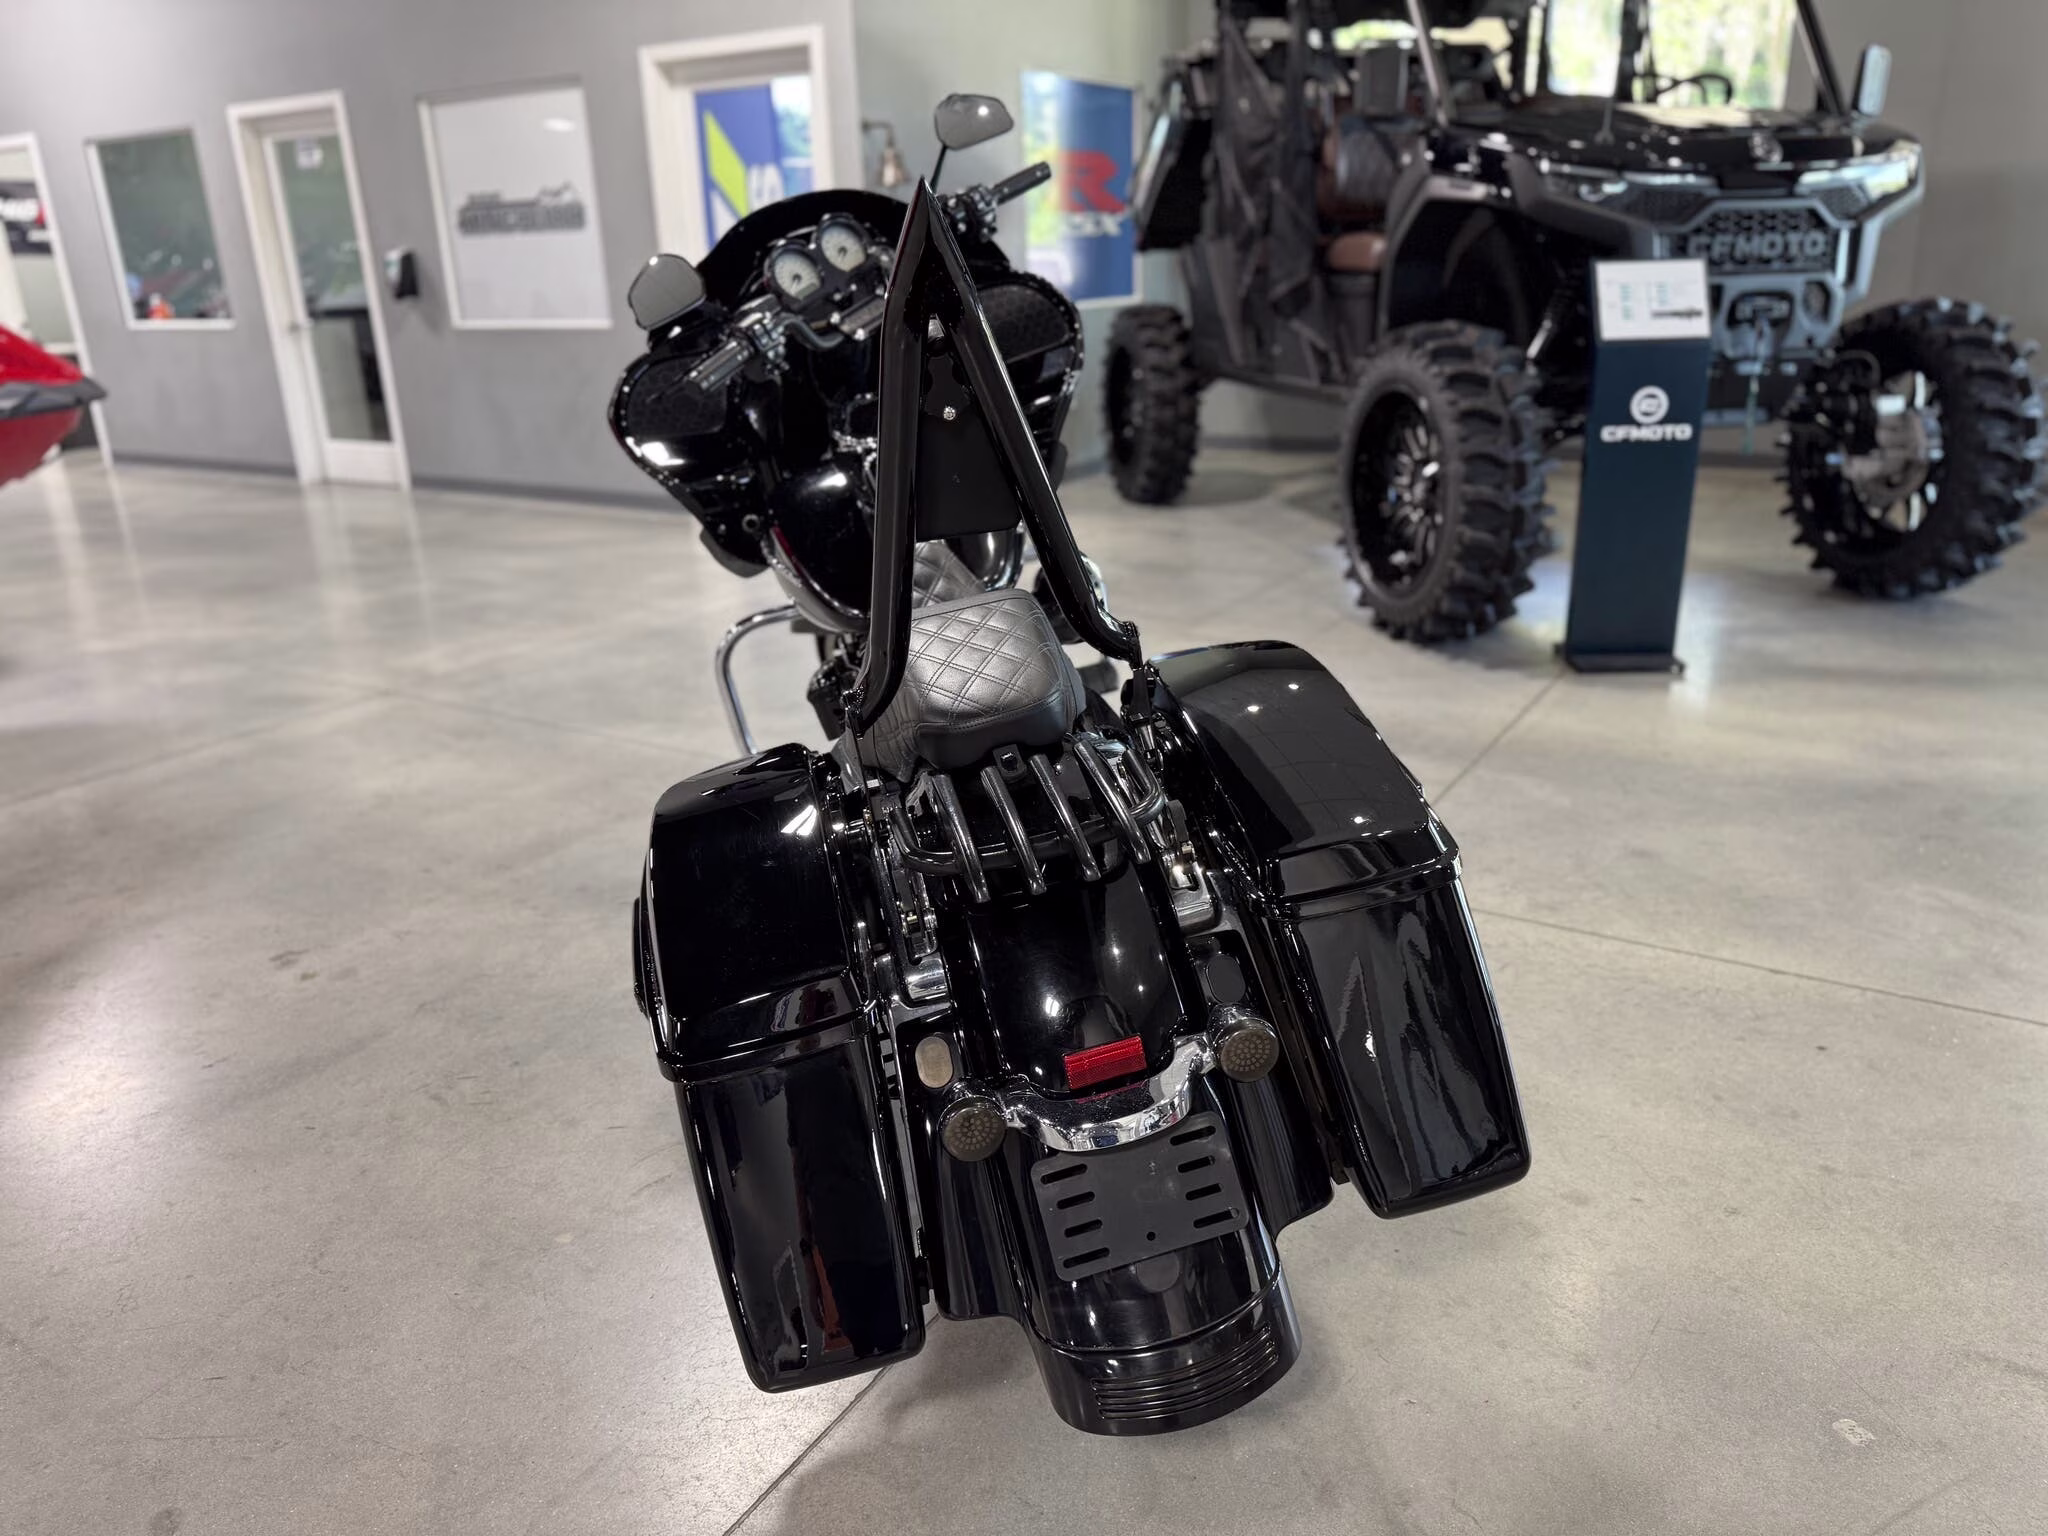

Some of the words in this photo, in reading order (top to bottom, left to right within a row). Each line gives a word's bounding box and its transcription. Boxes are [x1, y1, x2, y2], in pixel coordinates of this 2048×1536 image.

[1058, 149, 1125, 213] R
[1687, 230, 1826, 260] CFMOTO
[1600, 423, 1693, 443] CFMOTO
